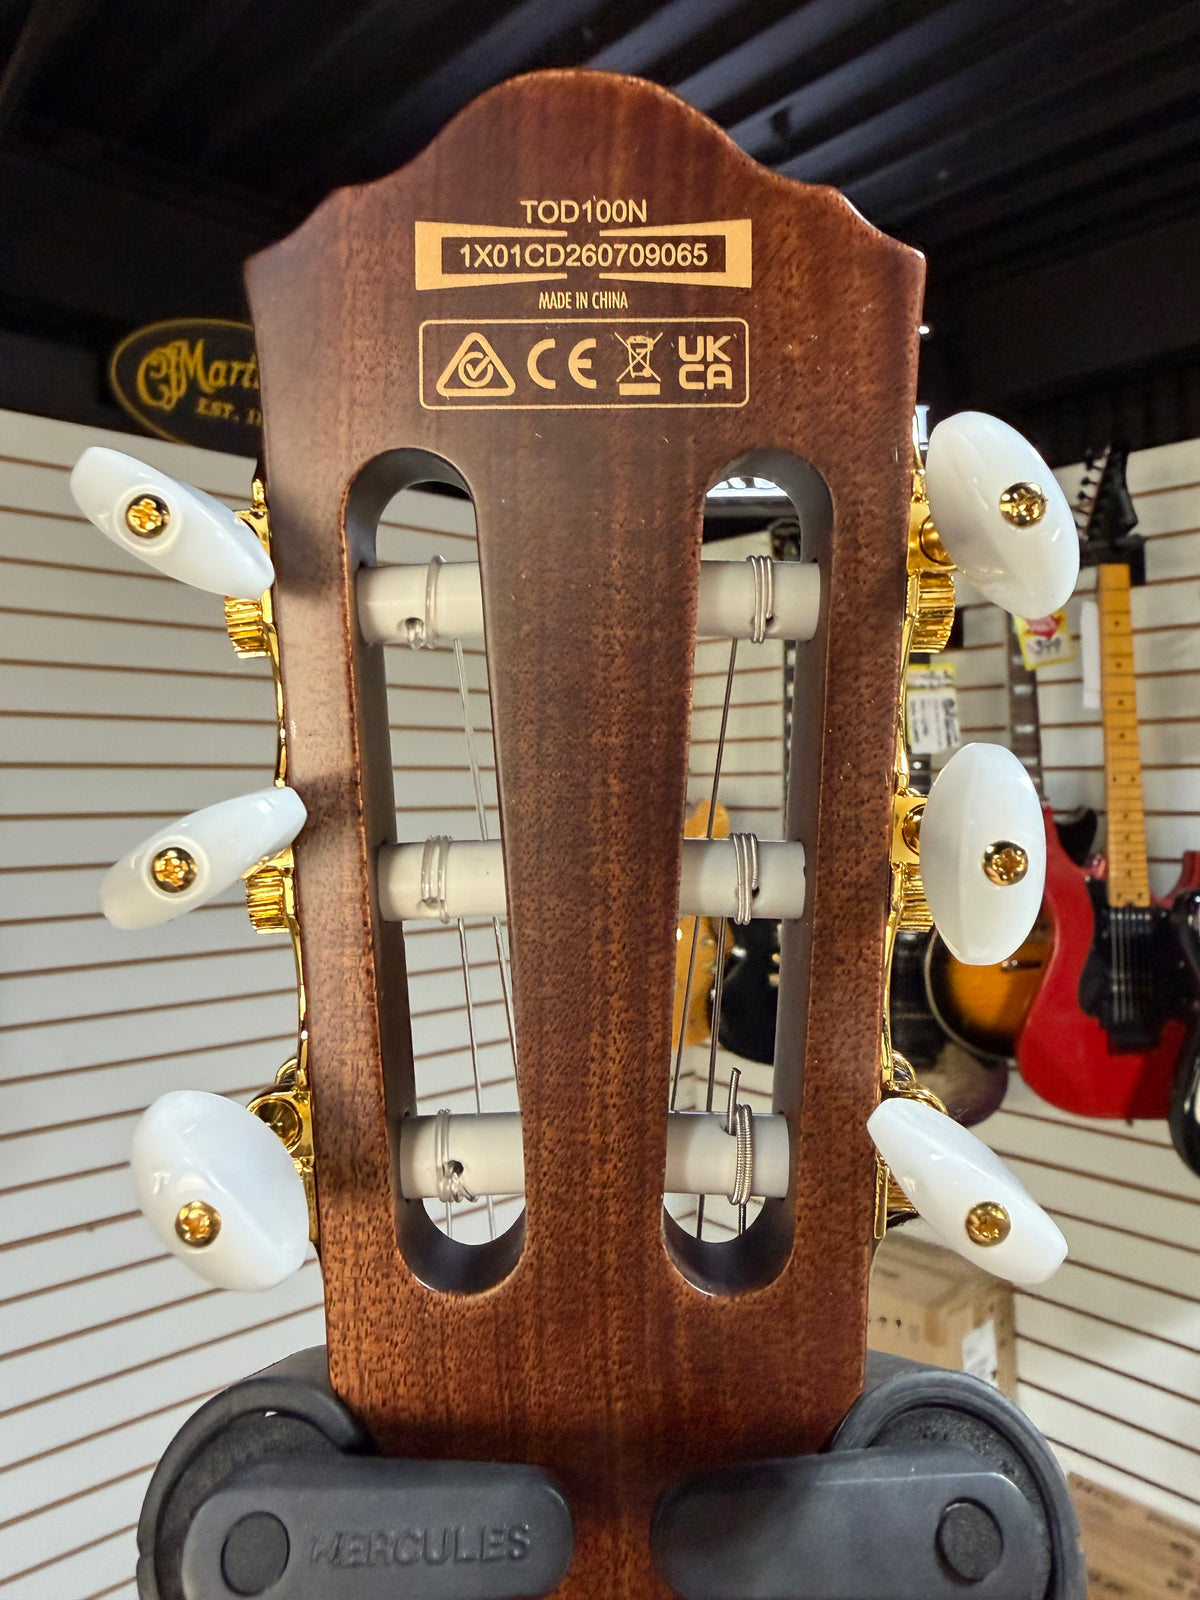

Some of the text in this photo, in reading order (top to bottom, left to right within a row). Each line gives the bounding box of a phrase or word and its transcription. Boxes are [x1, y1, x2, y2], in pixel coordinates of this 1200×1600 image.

[519, 199, 648, 224] TOD100N
[459, 243, 708, 268] 1X01CD260709065
[538, 291, 629, 310] MADE IN CHINA
[678, 335, 731, 363] UK
[526, 338, 597, 390] CE
[678, 363, 733, 391] CA
[310, 1523, 531, 1569] HERCULES
